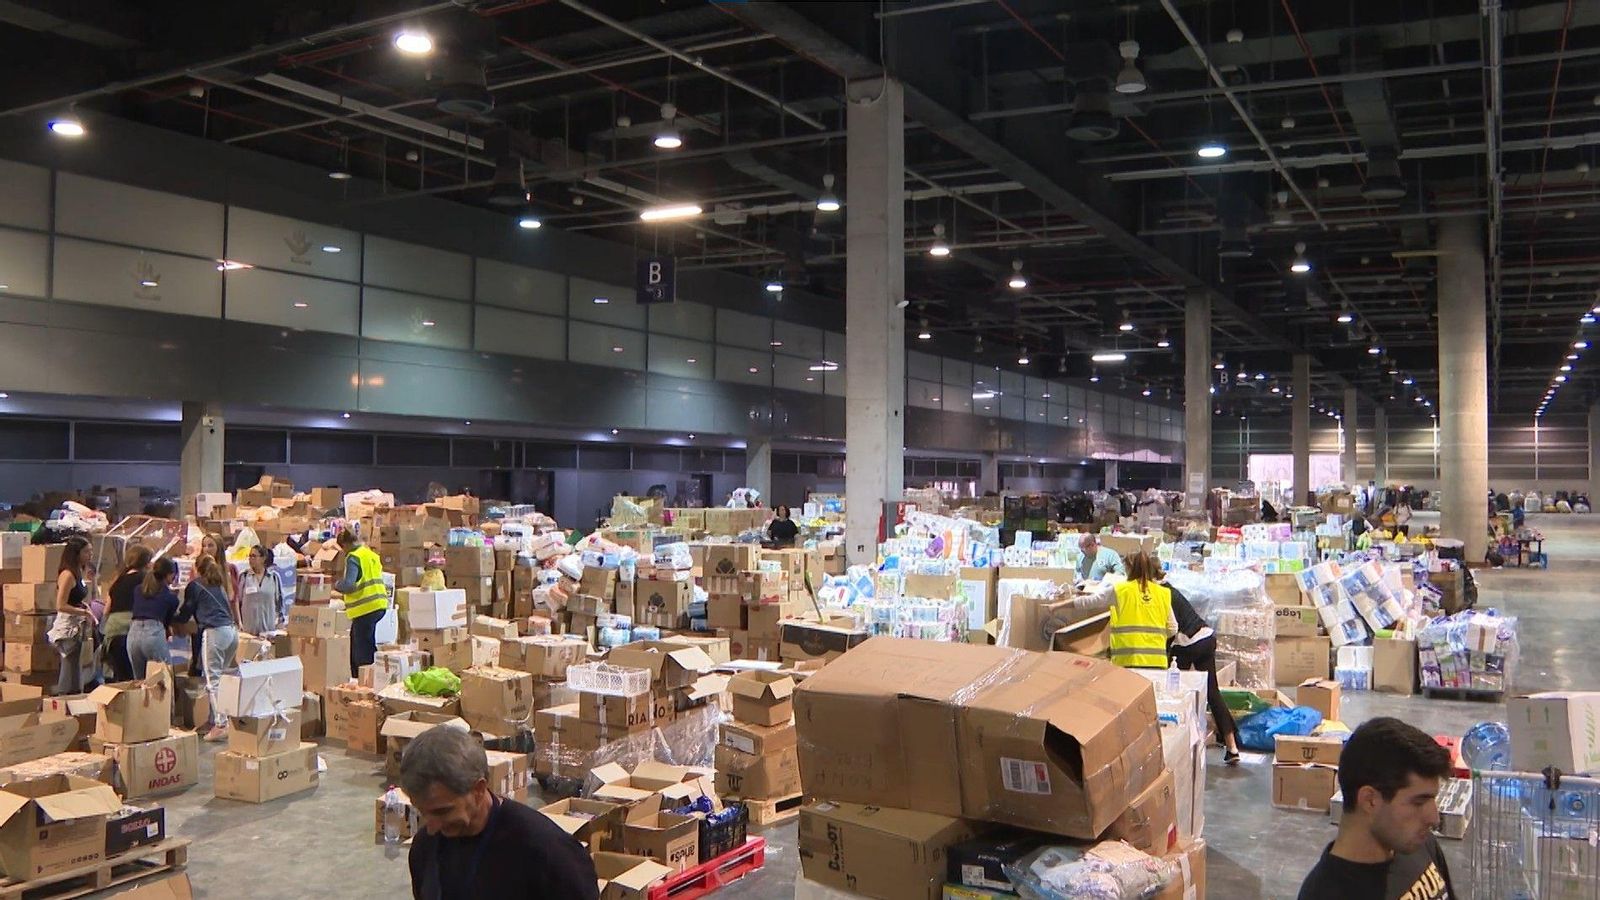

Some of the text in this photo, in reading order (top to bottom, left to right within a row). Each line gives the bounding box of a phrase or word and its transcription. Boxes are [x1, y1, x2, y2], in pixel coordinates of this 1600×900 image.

[649, 261, 662, 284] B
[1220, 371, 1229, 384] B
[148, 774, 181, 789] INDAS
